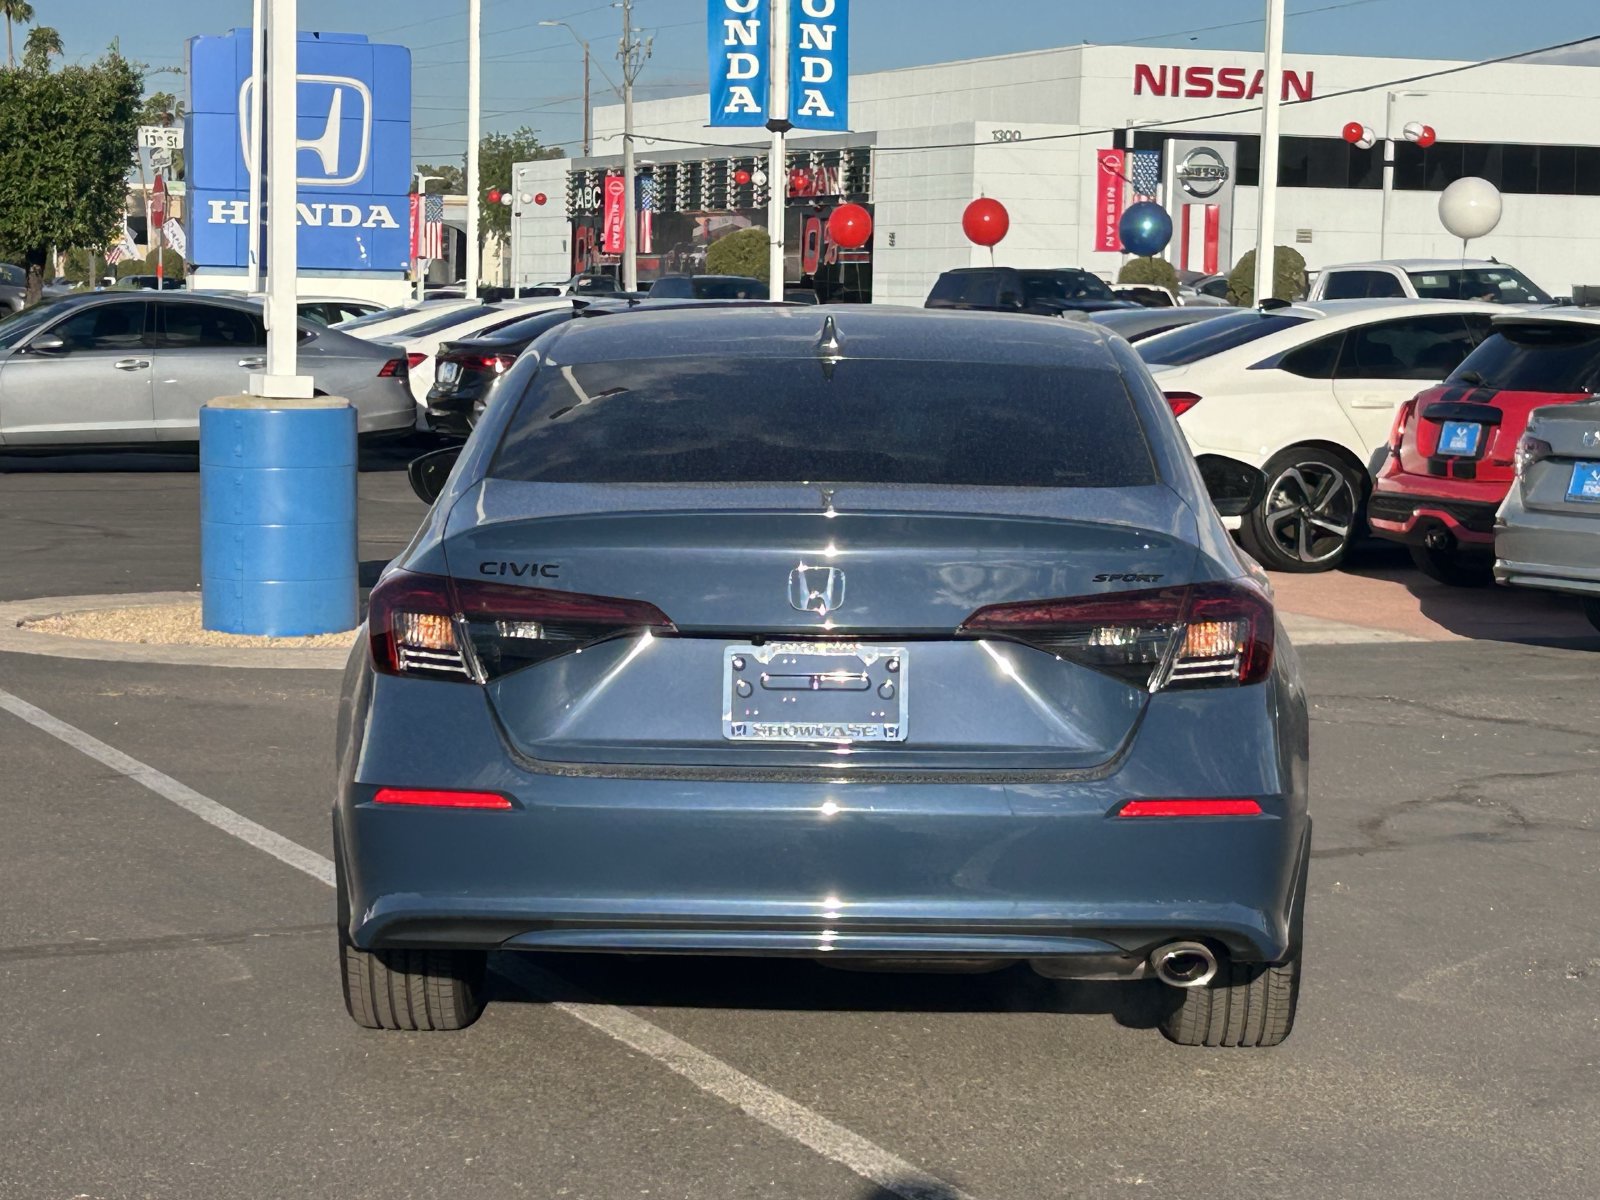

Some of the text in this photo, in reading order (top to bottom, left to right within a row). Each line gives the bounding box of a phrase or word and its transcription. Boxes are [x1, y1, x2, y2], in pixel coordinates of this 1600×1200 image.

[992, 129, 1022, 143] 1300
[575, 186, 602, 209] ABC
[207, 200, 400, 229] HNDA
[1106, 187, 1116, 247] NISSAN
[479, 562, 560, 578] CIVIC
[1092, 573, 1164, 583] SPORT
[752, 725, 878, 738] SHOWCASE
